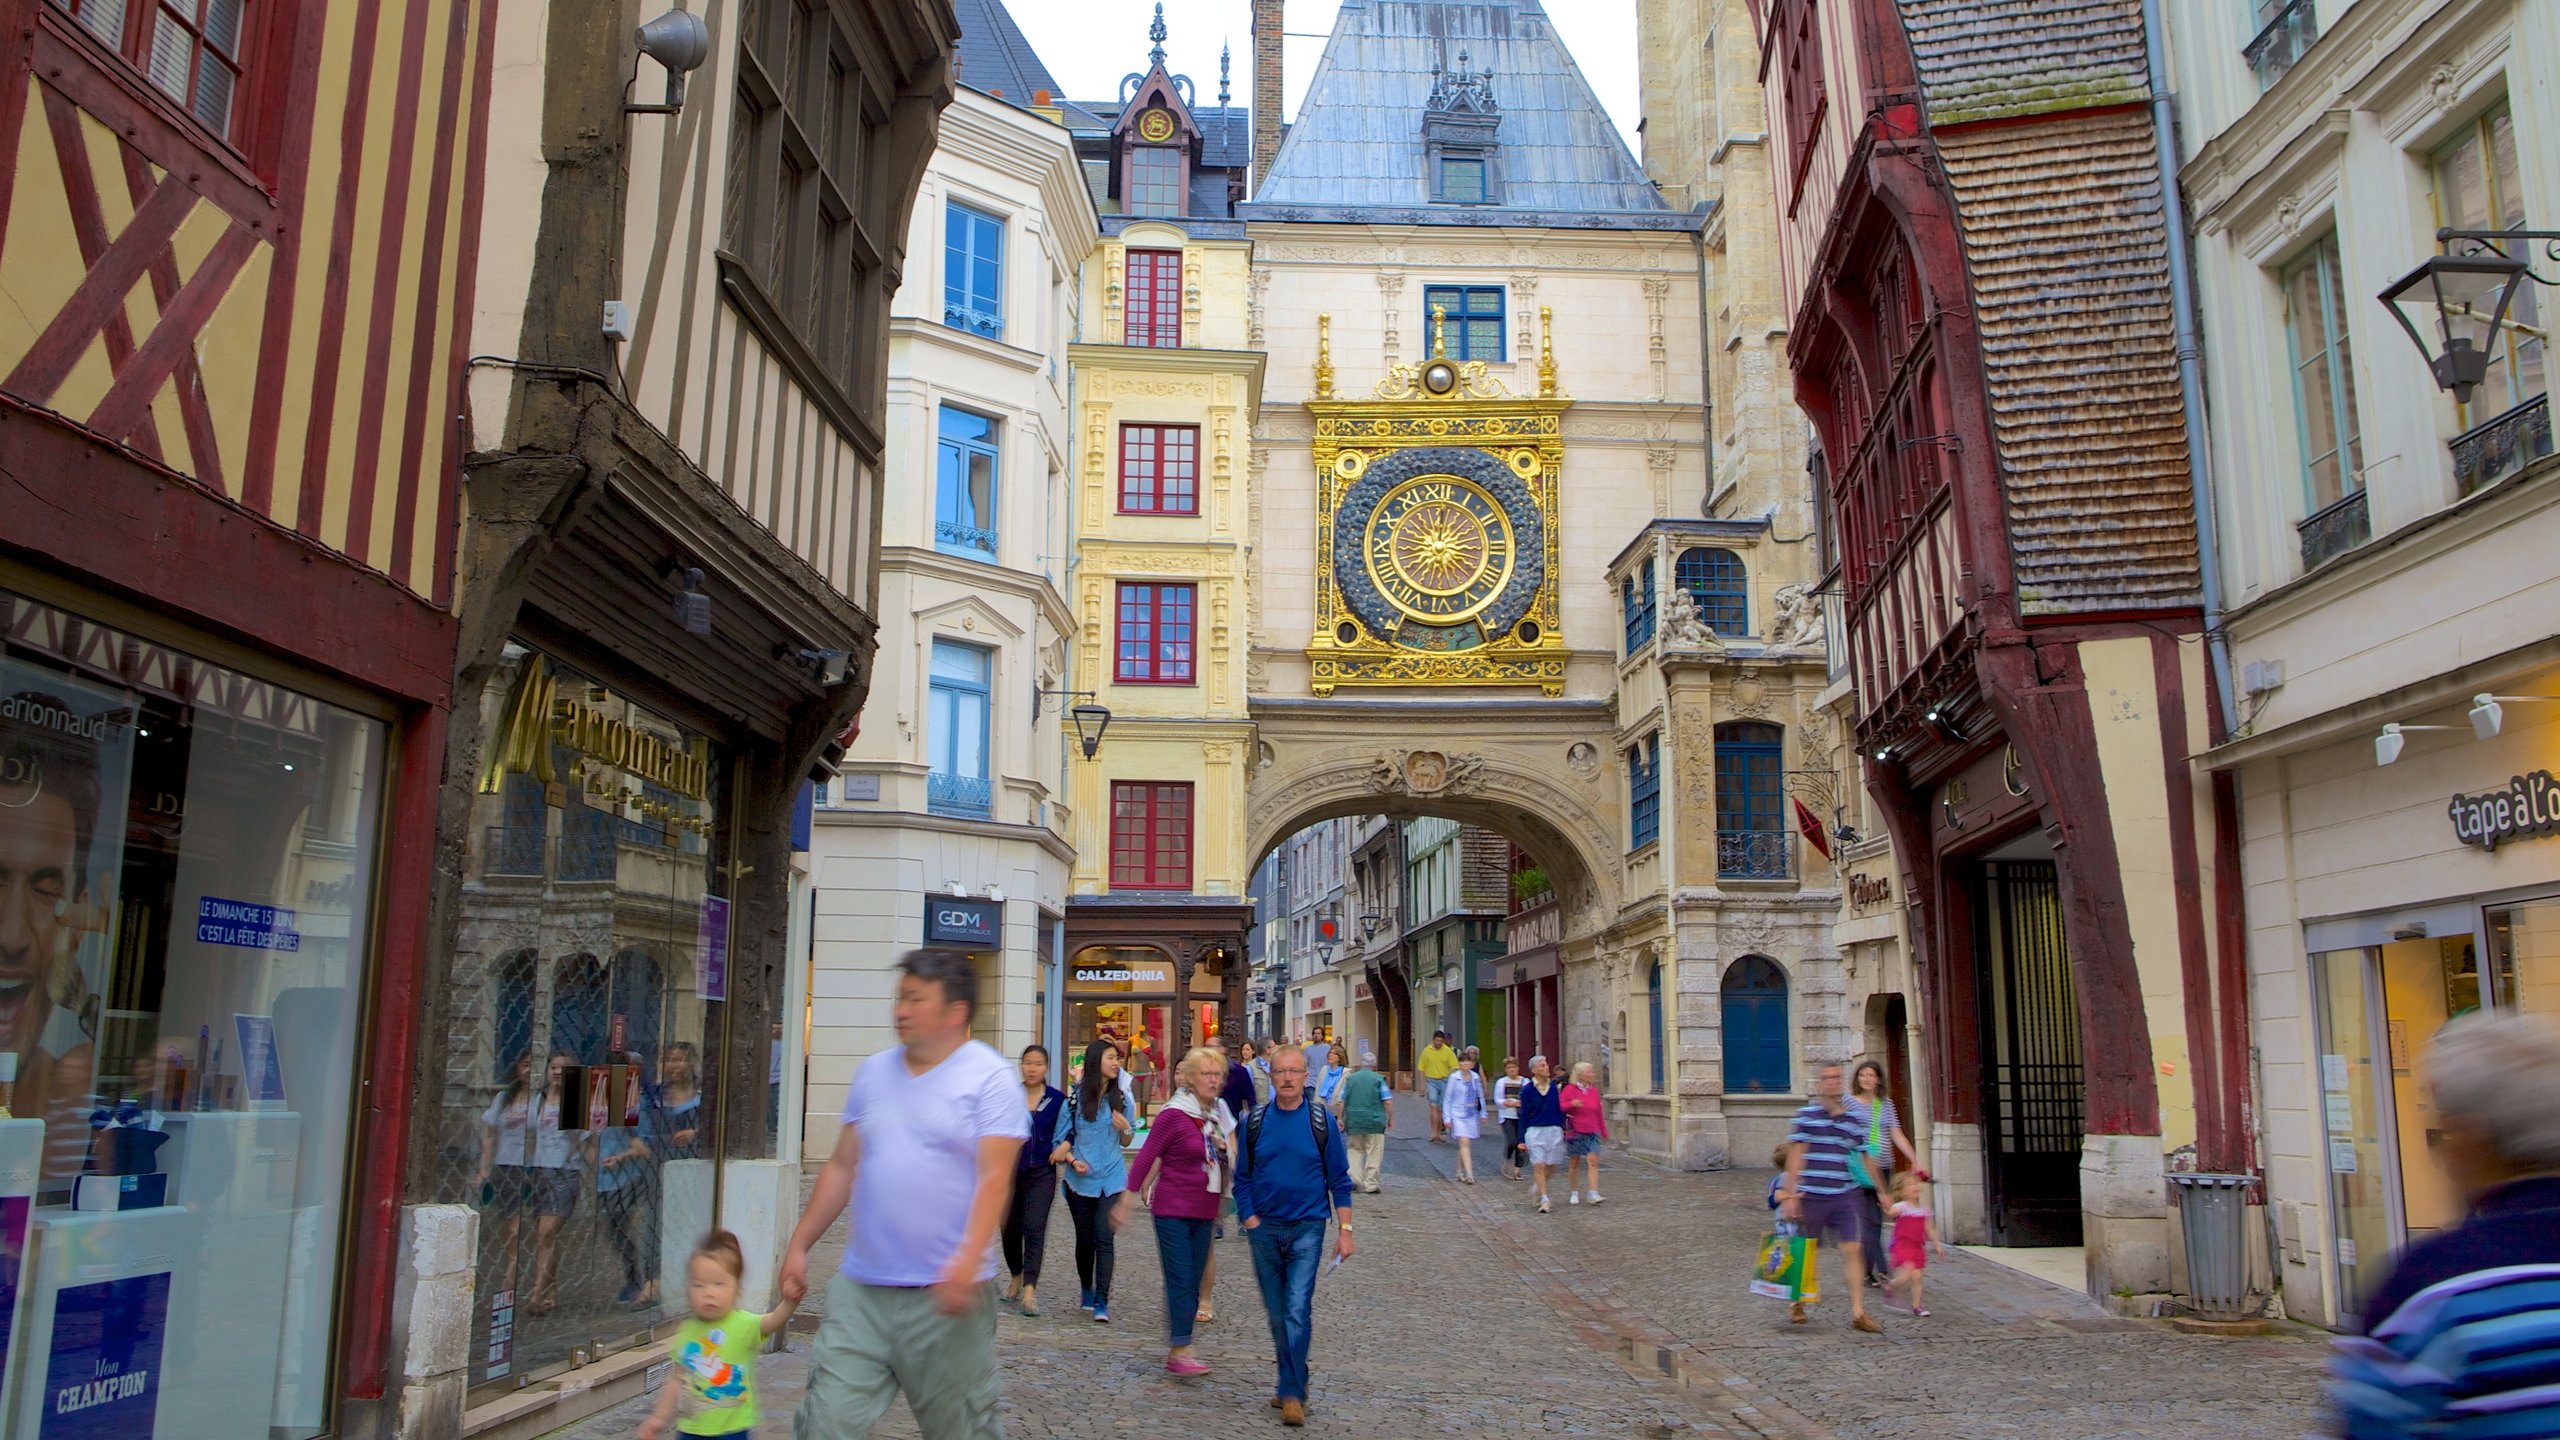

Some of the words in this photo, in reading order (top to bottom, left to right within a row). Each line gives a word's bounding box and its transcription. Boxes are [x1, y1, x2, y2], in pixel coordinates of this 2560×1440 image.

[0, 692, 108, 742] arionnaud
[480, 652, 708, 801] Marionnaud
[2451, 800, 2511, 846] tape
[2514, 783, 2530, 827] à
[200, 901, 211, 917] LE
[211, 903, 260, 924] DIMANCHE
[261, 909, 273, 925] 15
[938, 910, 980, 927] GDM
[199, 924, 223, 942] C'EST
[224, 927, 236, 943] LA
[237, 926, 256, 945] FÊTE
[257, 931, 274, 948] DES
[274, 930, 298, 950] PÈRES
[1076, 970, 1165, 981] CALZEDONIA
[92, 1358, 119, 1379] Mon
[57, 1370, 147, 1414] CHAMPION
